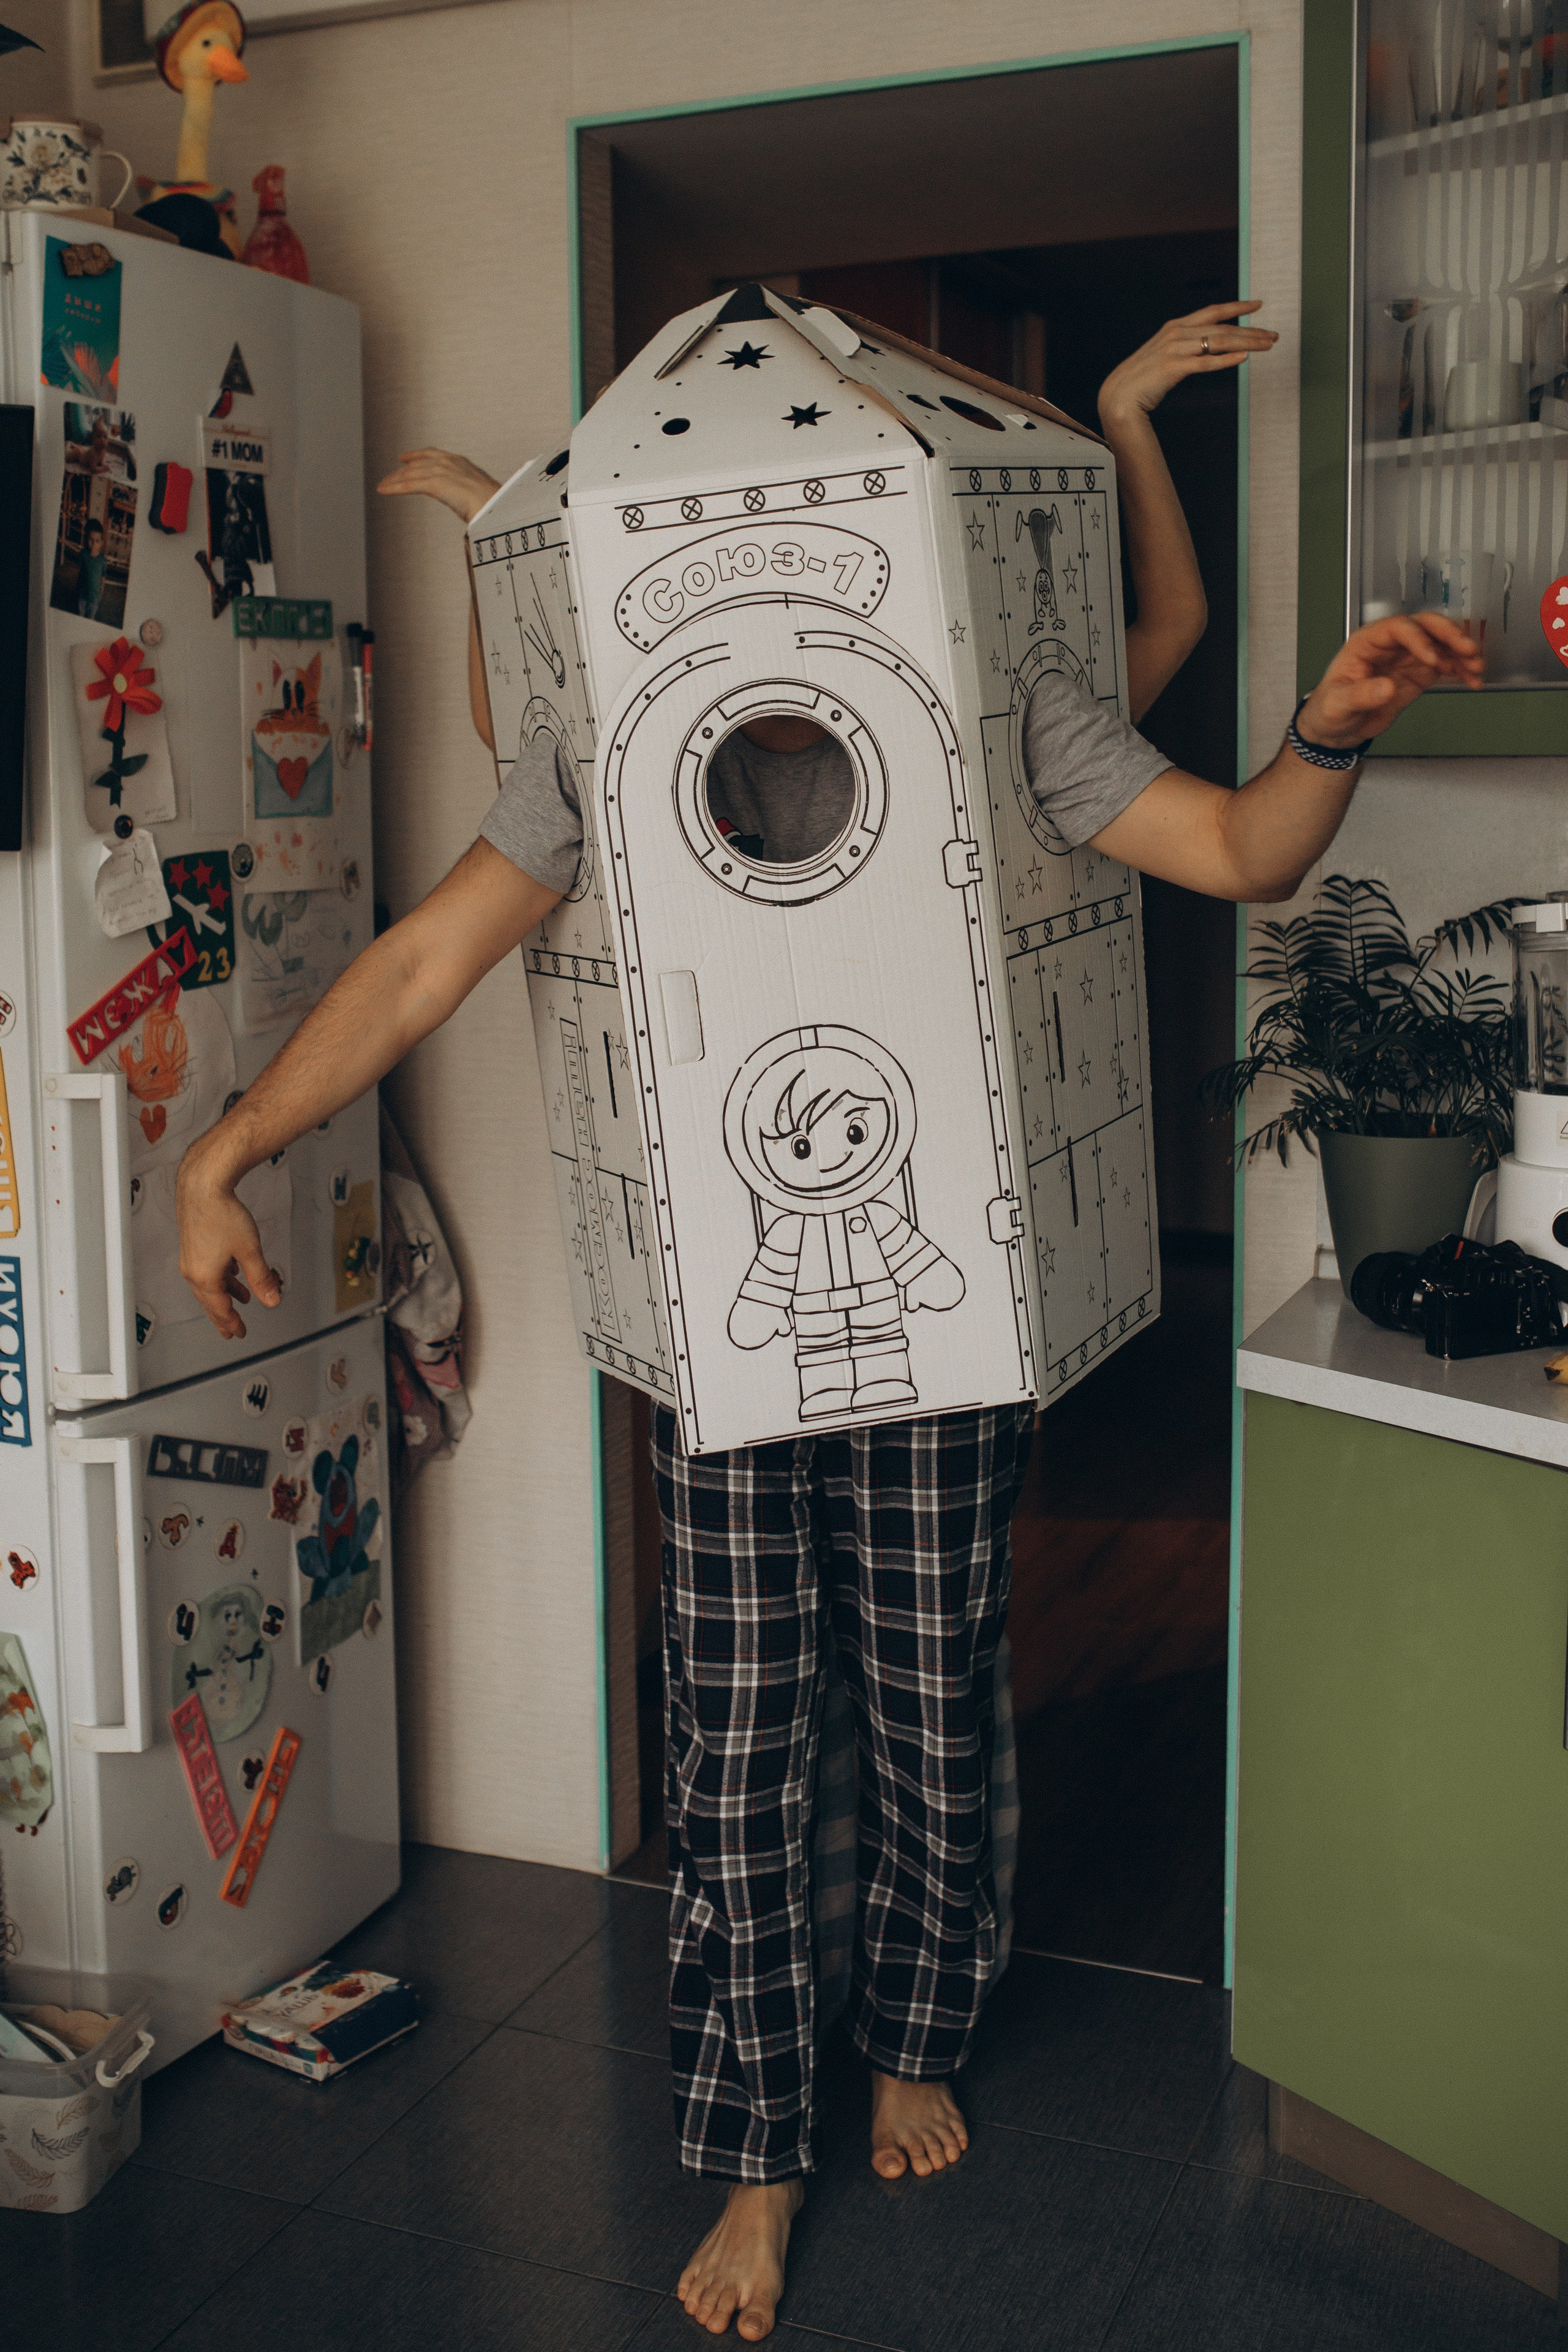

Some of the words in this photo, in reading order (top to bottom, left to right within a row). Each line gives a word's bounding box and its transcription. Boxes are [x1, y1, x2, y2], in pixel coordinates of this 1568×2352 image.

[212, 439, 228, 459] #1
[231, 440, 263, 464] MOM
[197, 947, 231, 981] 23
